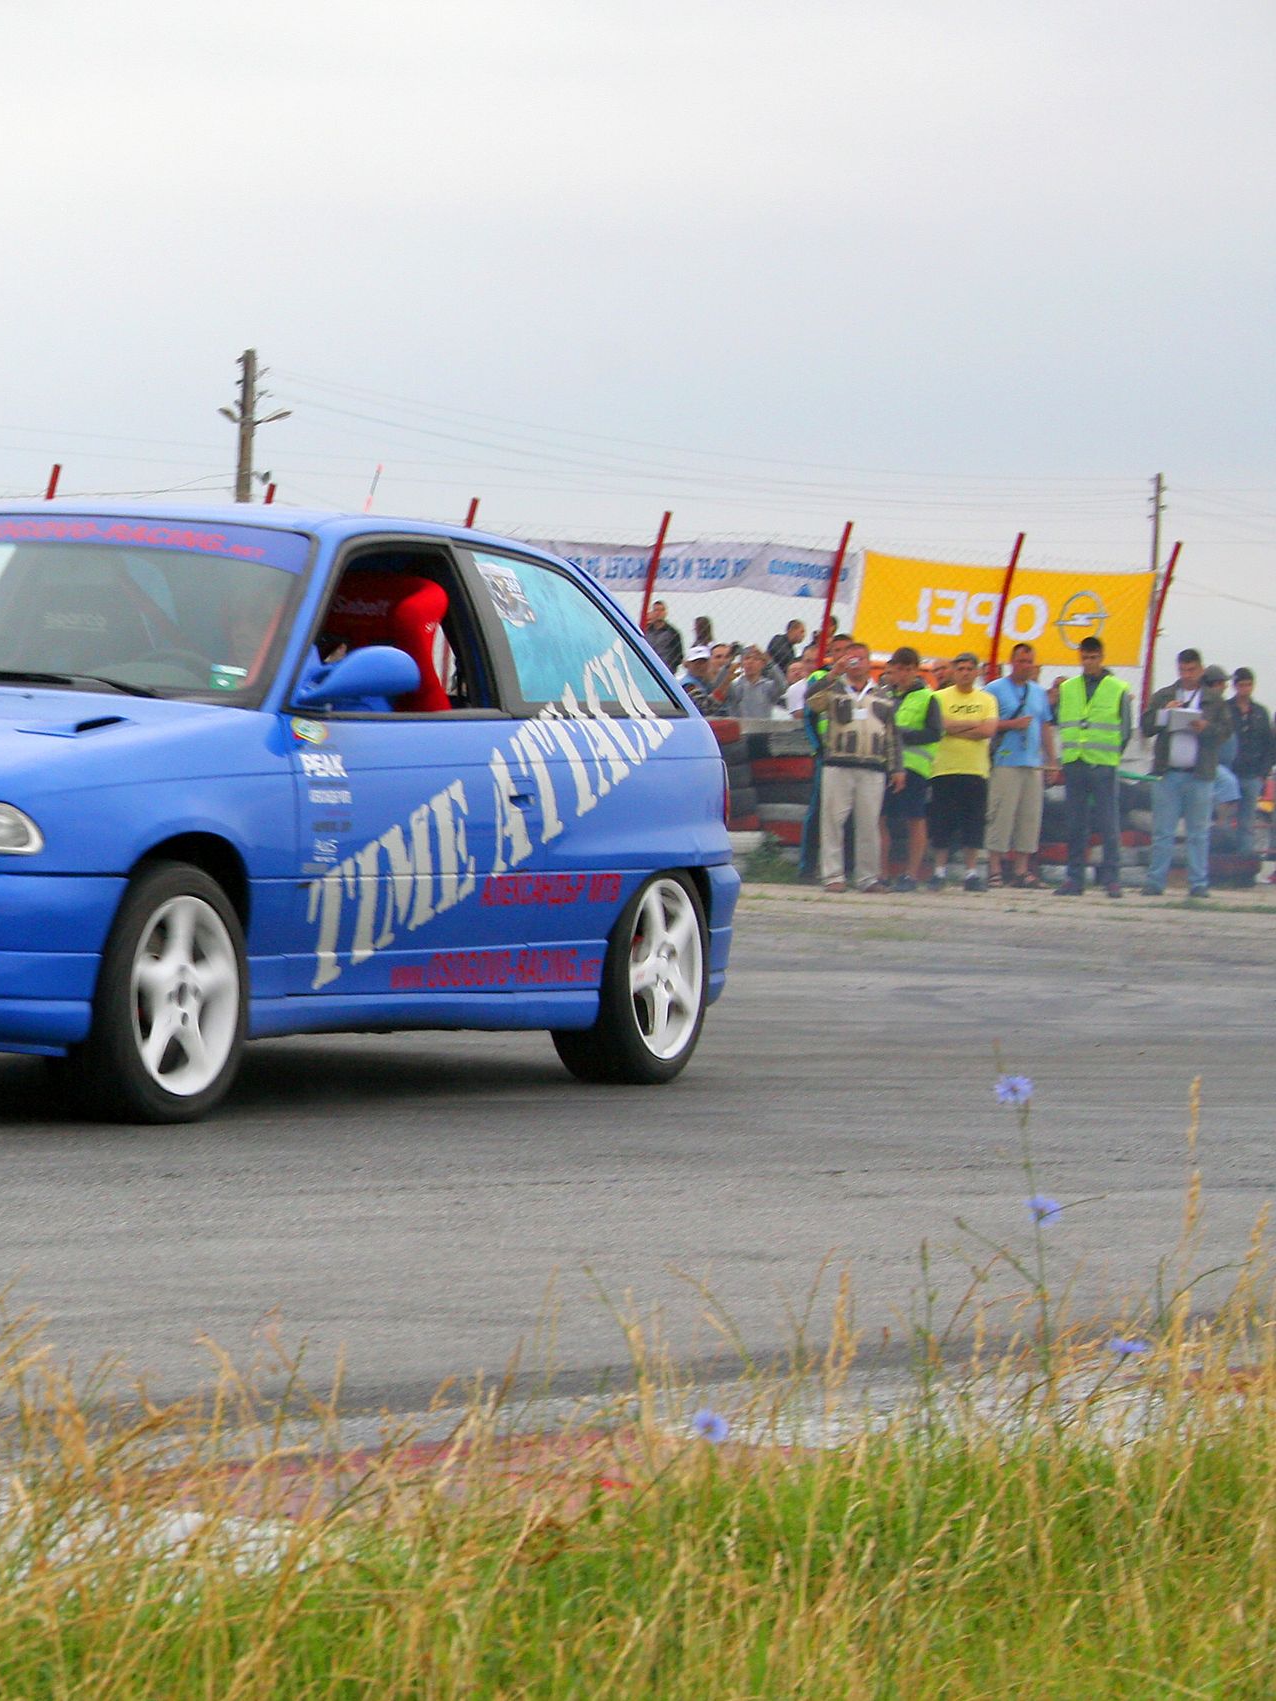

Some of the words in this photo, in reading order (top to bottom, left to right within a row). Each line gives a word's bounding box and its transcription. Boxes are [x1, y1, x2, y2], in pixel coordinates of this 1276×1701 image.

[298, 752, 349, 778] PEAK
[306, 779, 476, 991] TIME
[489, 638, 675, 875] ATTACK
